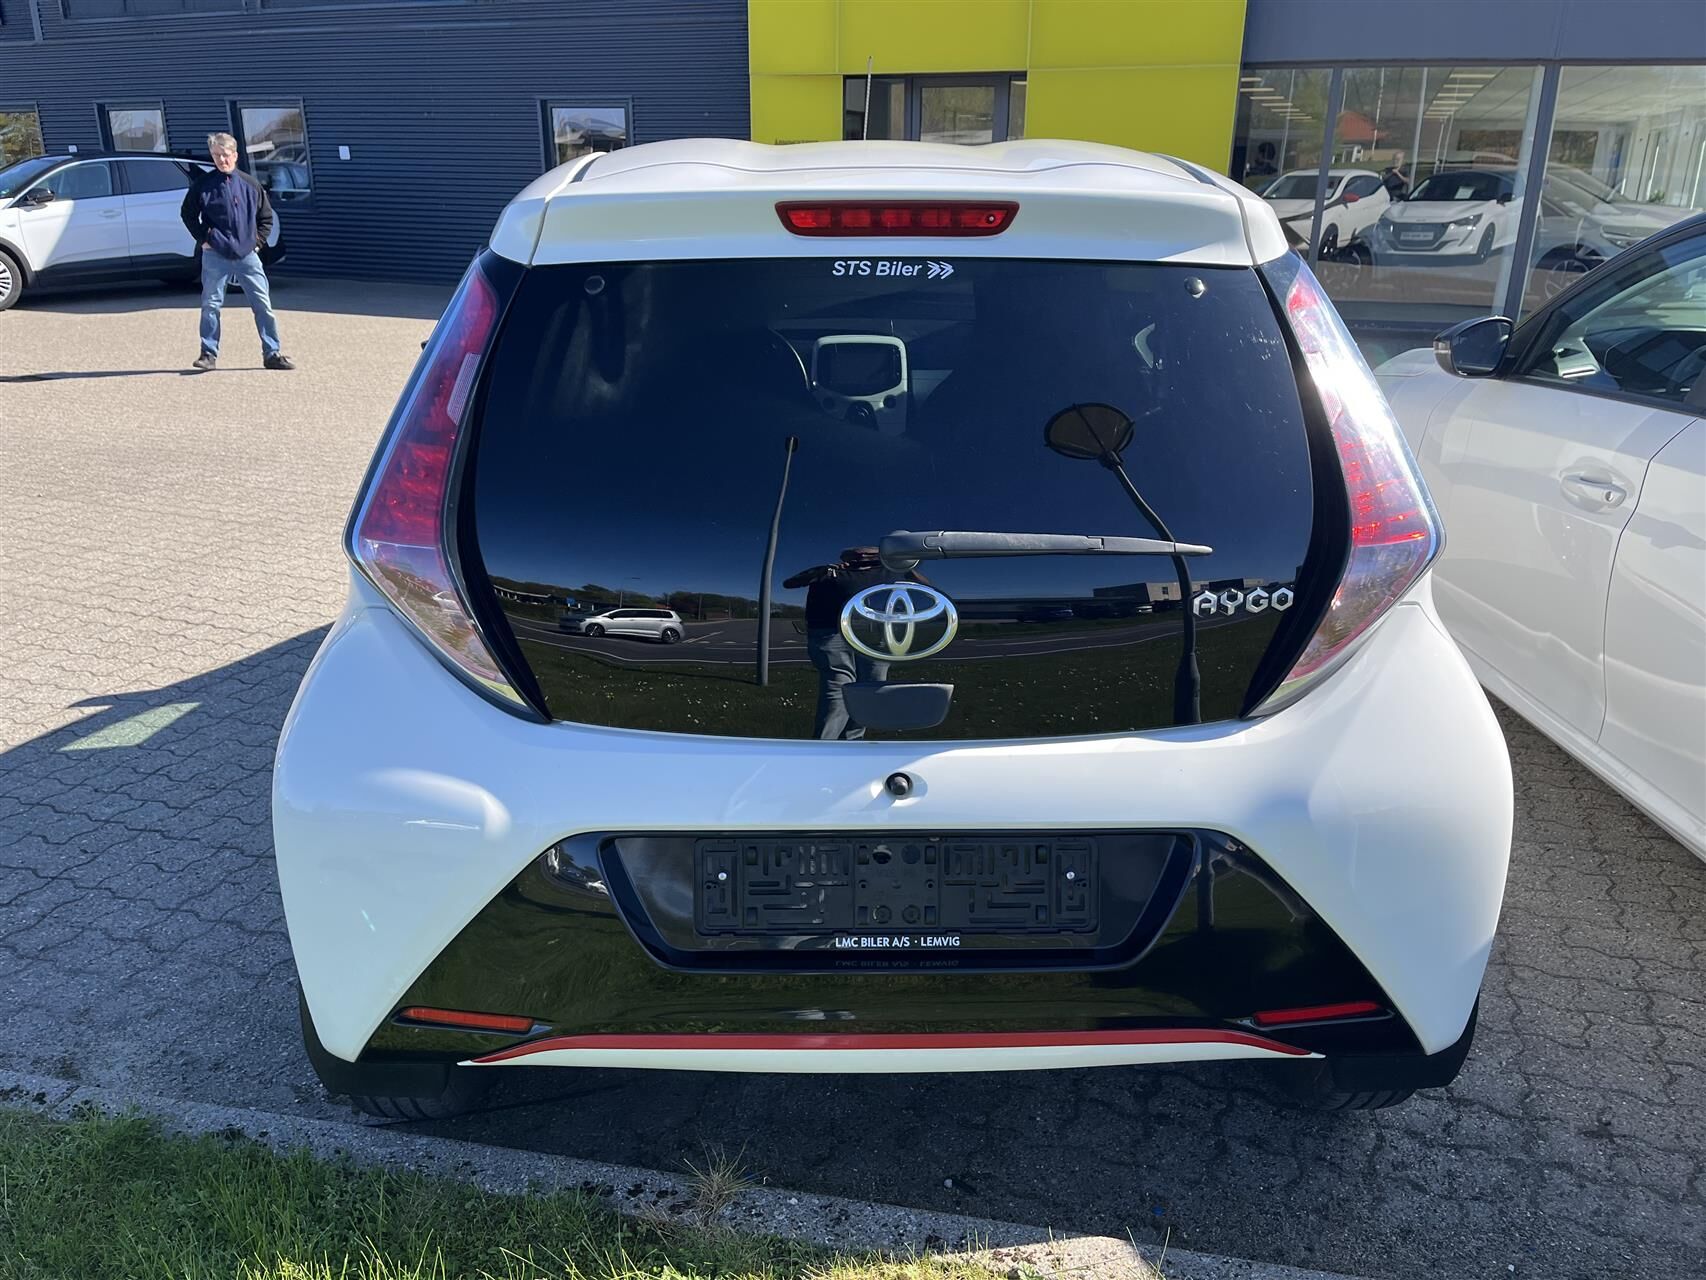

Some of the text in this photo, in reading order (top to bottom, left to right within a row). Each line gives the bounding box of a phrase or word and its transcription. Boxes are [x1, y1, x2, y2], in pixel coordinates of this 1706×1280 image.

[832, 261, 922, 276] STS Biler
[1193, 587, 1295, 617] AYGO
[835, 936, 960, 947] LMC BILER A/S LEMVIG
